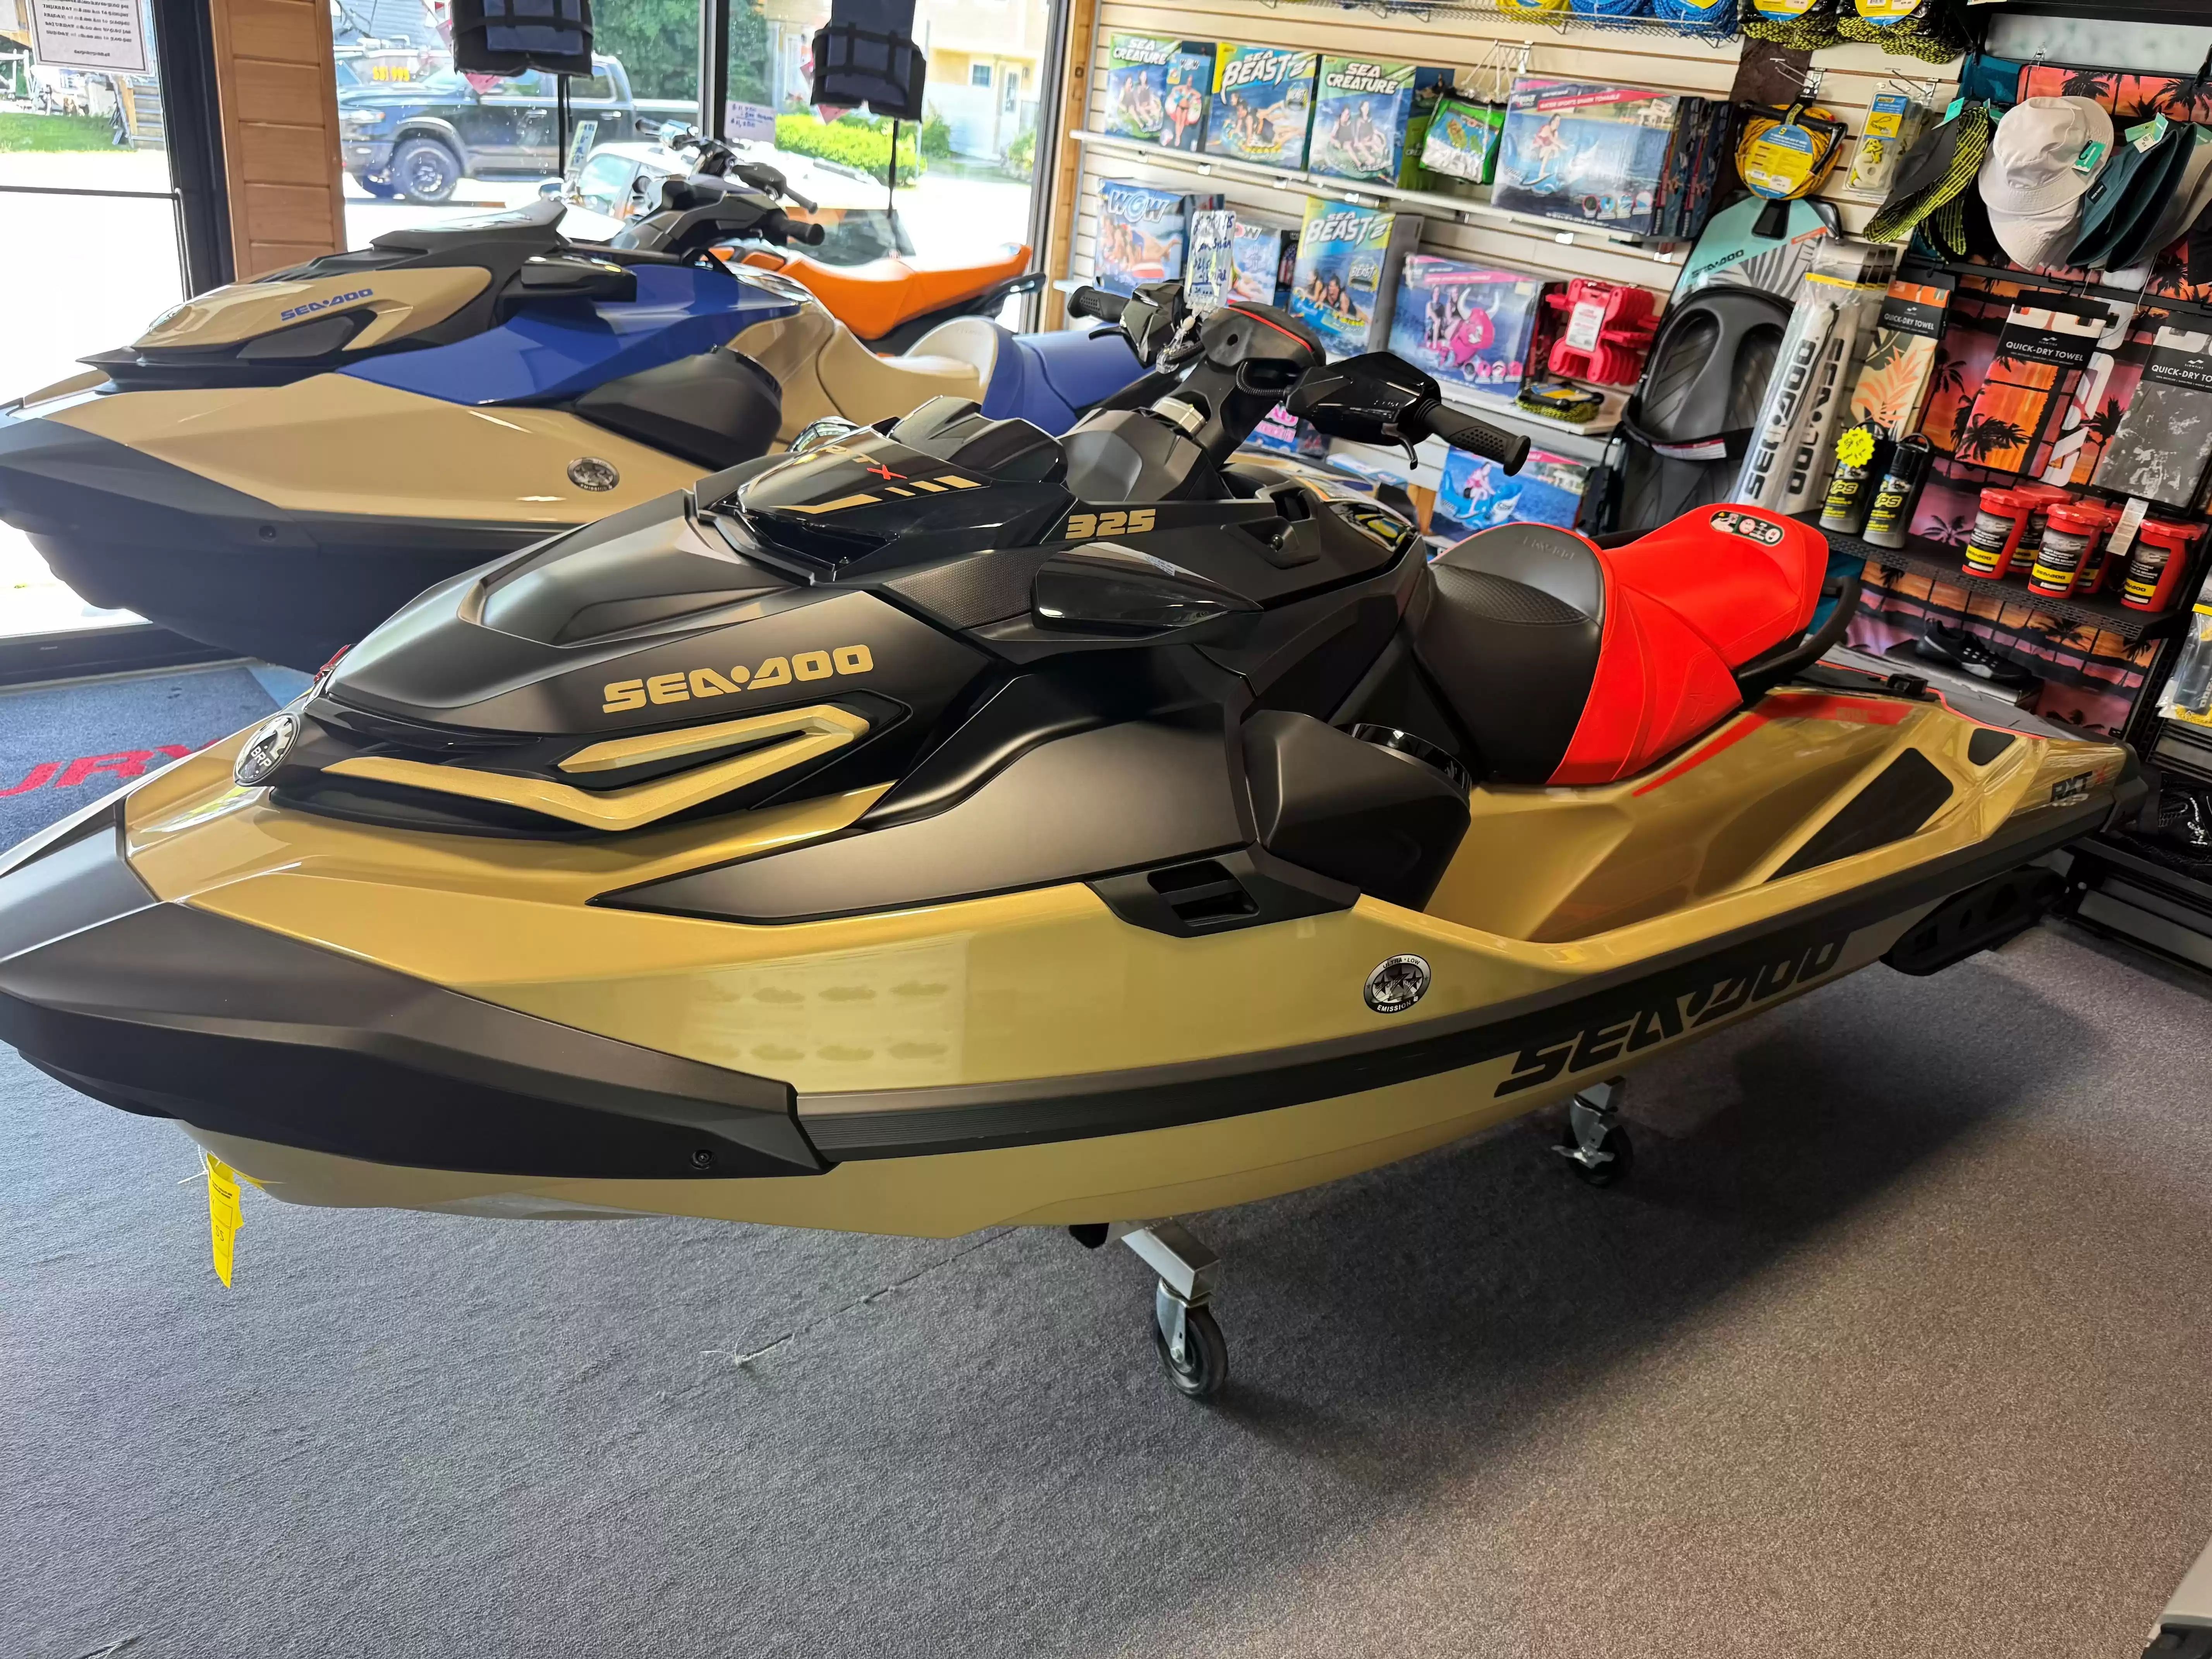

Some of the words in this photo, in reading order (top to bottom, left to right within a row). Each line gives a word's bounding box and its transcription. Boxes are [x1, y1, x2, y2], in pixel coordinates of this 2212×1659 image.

[1128, 38, 1156, 51] SEA
[1113, 47, 1167, 65] CREATURE
[1243, 50, 1274, 63] SEA
[1221, 54, 1292, 105] BEAST
[1289, 59, 1308, 78] 2
[1345, 63, 1381, 78] SEA
[1326, 73, 1399, 94] CREATURE
[1108, 188, 1170, 223] WOW
[1327, 211, 1356, 220] SEA
[1234, 222, 1263, 240] OW
[1304, 217, 1373, 256] BEAST
[1370, 223, 1387, 239] 2
[1914, 320, 1934, 330] TOWEL
[2006, 341, 2054, 356] QUICK-DRY
[2054, 350, 2083, 361] TOWEL
[2152, 364, 2200, 380] QUICK-DRY
[1065, 508, 1156, 539] 325
[250, 745, 272, 768] BRP
[1383, 957, 1402, 969] ULTRA
[1377, 1001, 1411, 1012] EMISSION
